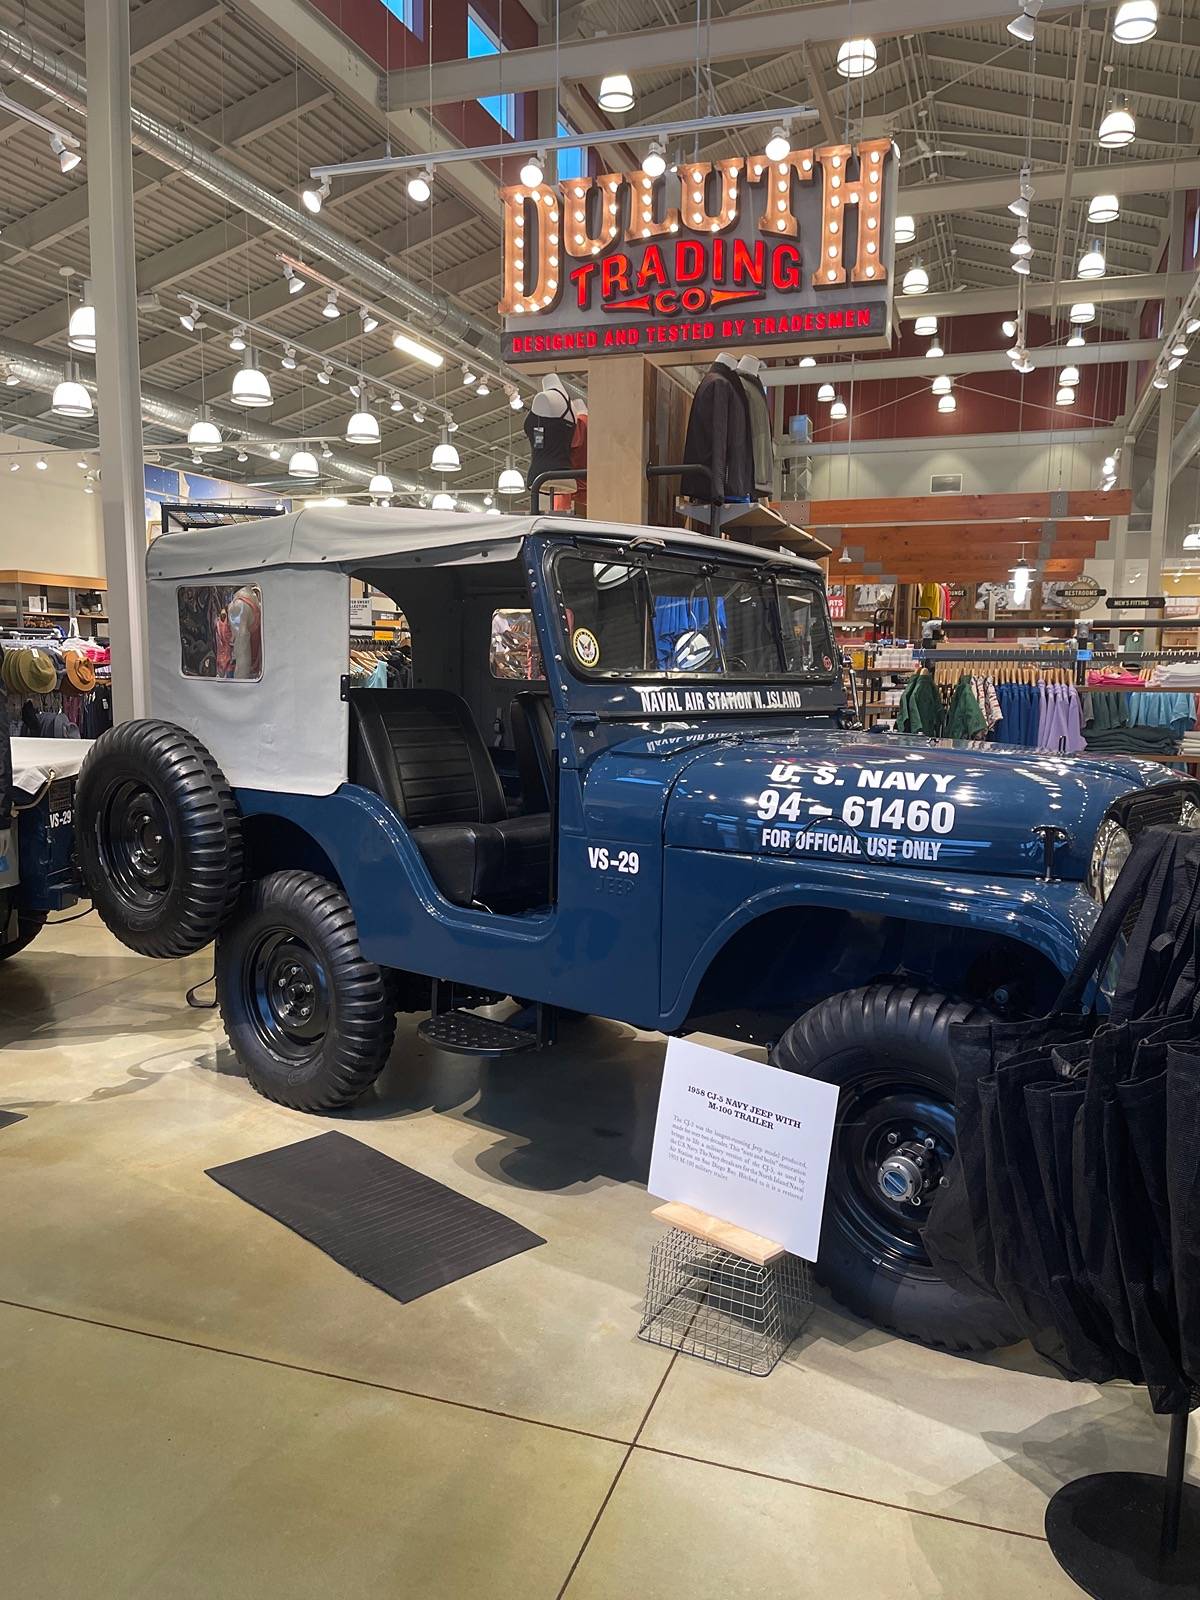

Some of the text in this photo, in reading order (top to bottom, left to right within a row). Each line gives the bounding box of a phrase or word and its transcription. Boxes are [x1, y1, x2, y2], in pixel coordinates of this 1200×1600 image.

[498, 138, 892, 316] DULUTH
[570, 239, 800, 307] TRADING
[655, 287, 707, 313] CO
[512, 308, 871, 353] DESIGNED AND TESTED BY TRADESMEN
[641, 691, 682, 713] NAVAL
[685, 691, 704, 711] AIR
[707, 690, 753, 710] STATION
[767, 690, 801, 708] ISLAND
[769, 765, 956, 793] U. S. NAVY
[49, 810, 72, 828] VS-29
[757, 790, 802, 822] 94
[842, 796, 956, 834] 61460
[762, 829, 942, 861] FOR OFFICIAL USE ONLY
[588, 847, 640, 874] VS-29
[687, 1085, 800, 1129] 1958 CJ-5 NAVY JEEP WITH
[708, 1101, 774, 1130] M-100 TRAILER
